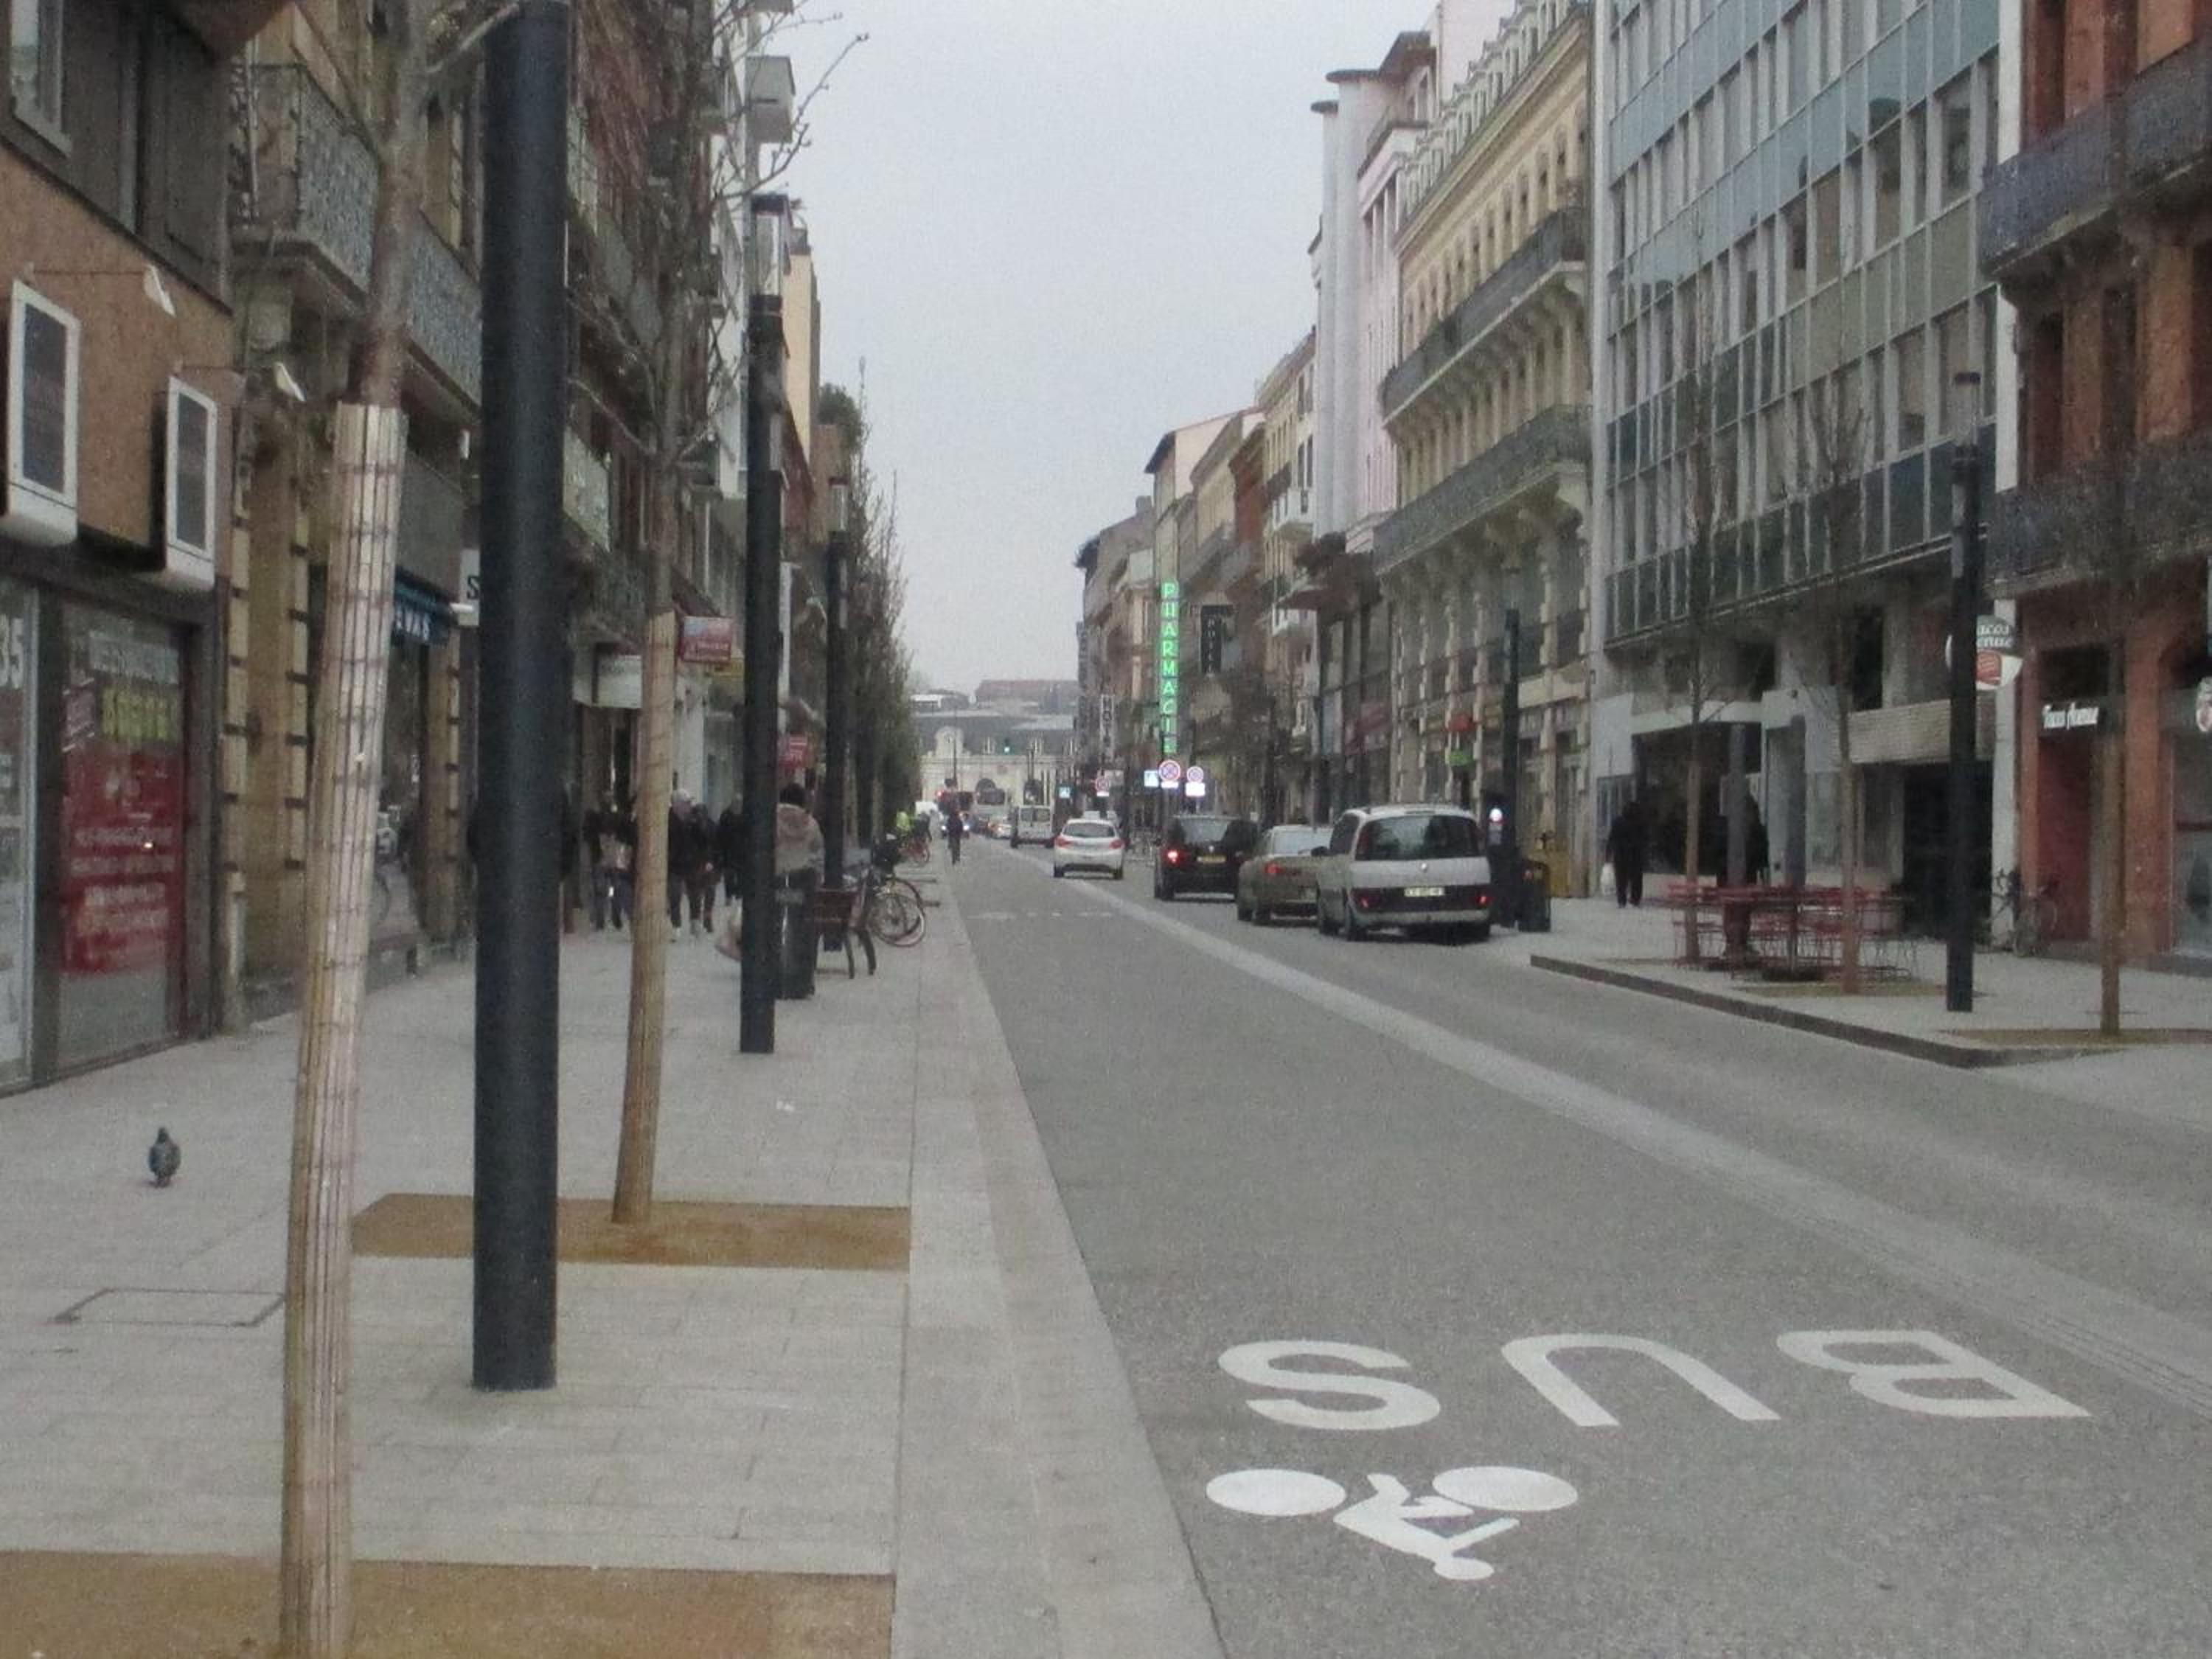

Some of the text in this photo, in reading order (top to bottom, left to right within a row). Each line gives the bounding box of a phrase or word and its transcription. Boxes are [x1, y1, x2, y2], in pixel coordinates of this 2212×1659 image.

[1162, 581, 1177, 754] PHARMACIE
[1975, 625, 2009, 636] acos
[1219, 1331, 2090, 1430] BUS
